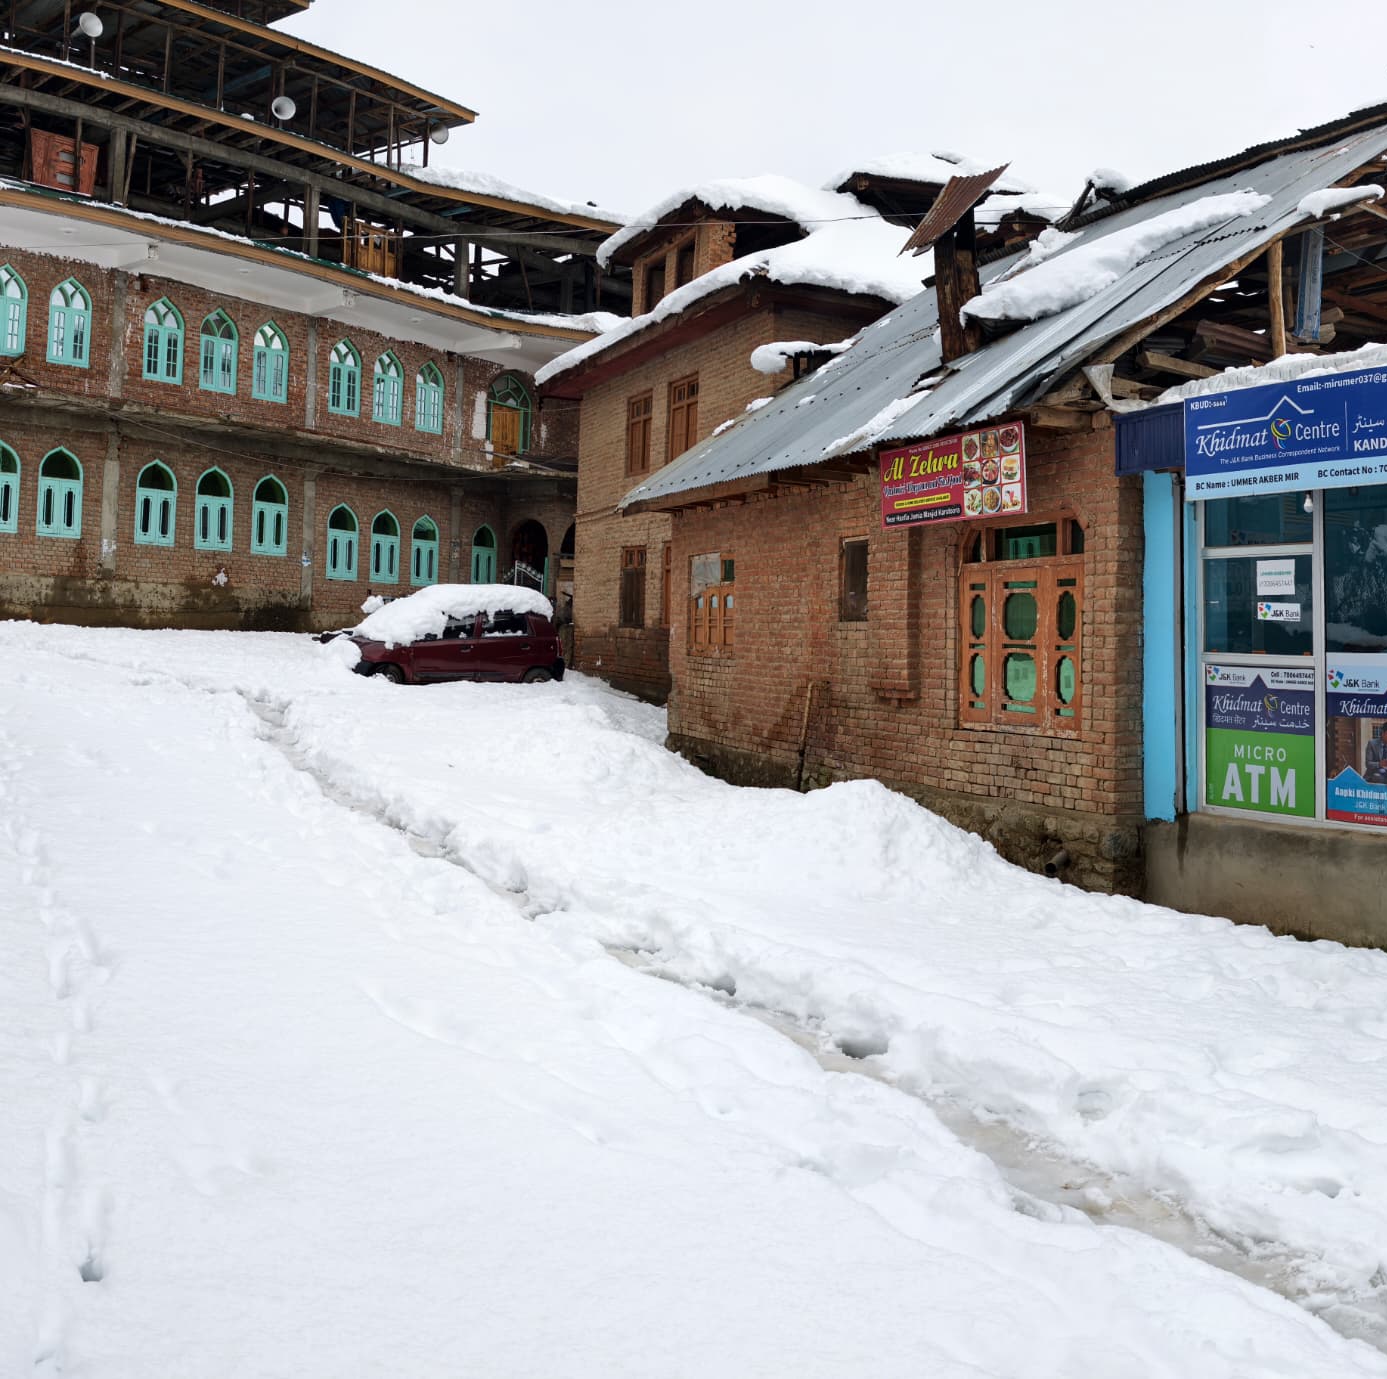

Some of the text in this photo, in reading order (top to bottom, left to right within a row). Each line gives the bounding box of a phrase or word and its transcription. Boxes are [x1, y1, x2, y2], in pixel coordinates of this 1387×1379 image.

[1195, 420, 1340, 457] Khidmat Centre
[883, 449, 959, 482] Al Zehra
[1317, 469, 1328, 478] BC
[1328, 466, 1360, 478] Contact
[1361, 465, 1373, 475] No
[1195, 472, 1299, 491] BC Name UMMER AKBER MIR
[1285, 609, 1300, 618] Bank
[1343, 678, 1380, 689] J&K Bank
[1212, 693, 1310, 716] Khidmat Centre
[1339, 698, 1387, 716] Khidmat
[1279, 718, 1310, 729] خدمت
[1233, 743, 1287, 762] MICRO
[1221, 761, 1297, 809] ATM
